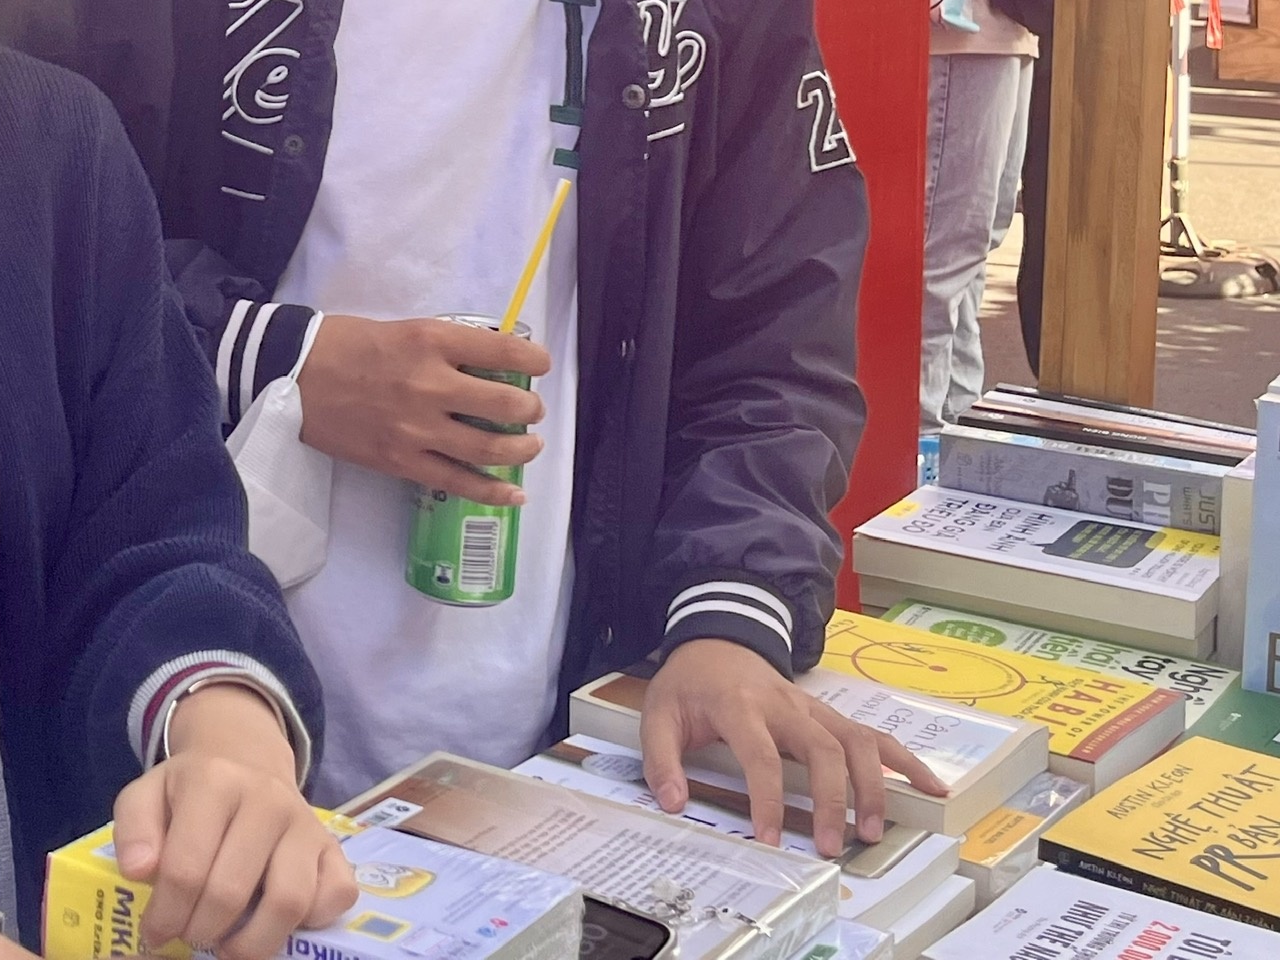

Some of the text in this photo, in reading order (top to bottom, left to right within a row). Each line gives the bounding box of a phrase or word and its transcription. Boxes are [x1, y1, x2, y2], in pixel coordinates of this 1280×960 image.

[797, 70, 857, 173] 2
[1033, 679, 1126, 738] HABI
[1081, 704, 1117, 726] POWER
[1106, 787, 1153, 820] AUSTIN
[1147, 764, 1194, 795] KLEON
[1132, 763, 1280, 860] NGHỆ THUẬT
[1190, 844, 1270, 891] PR
